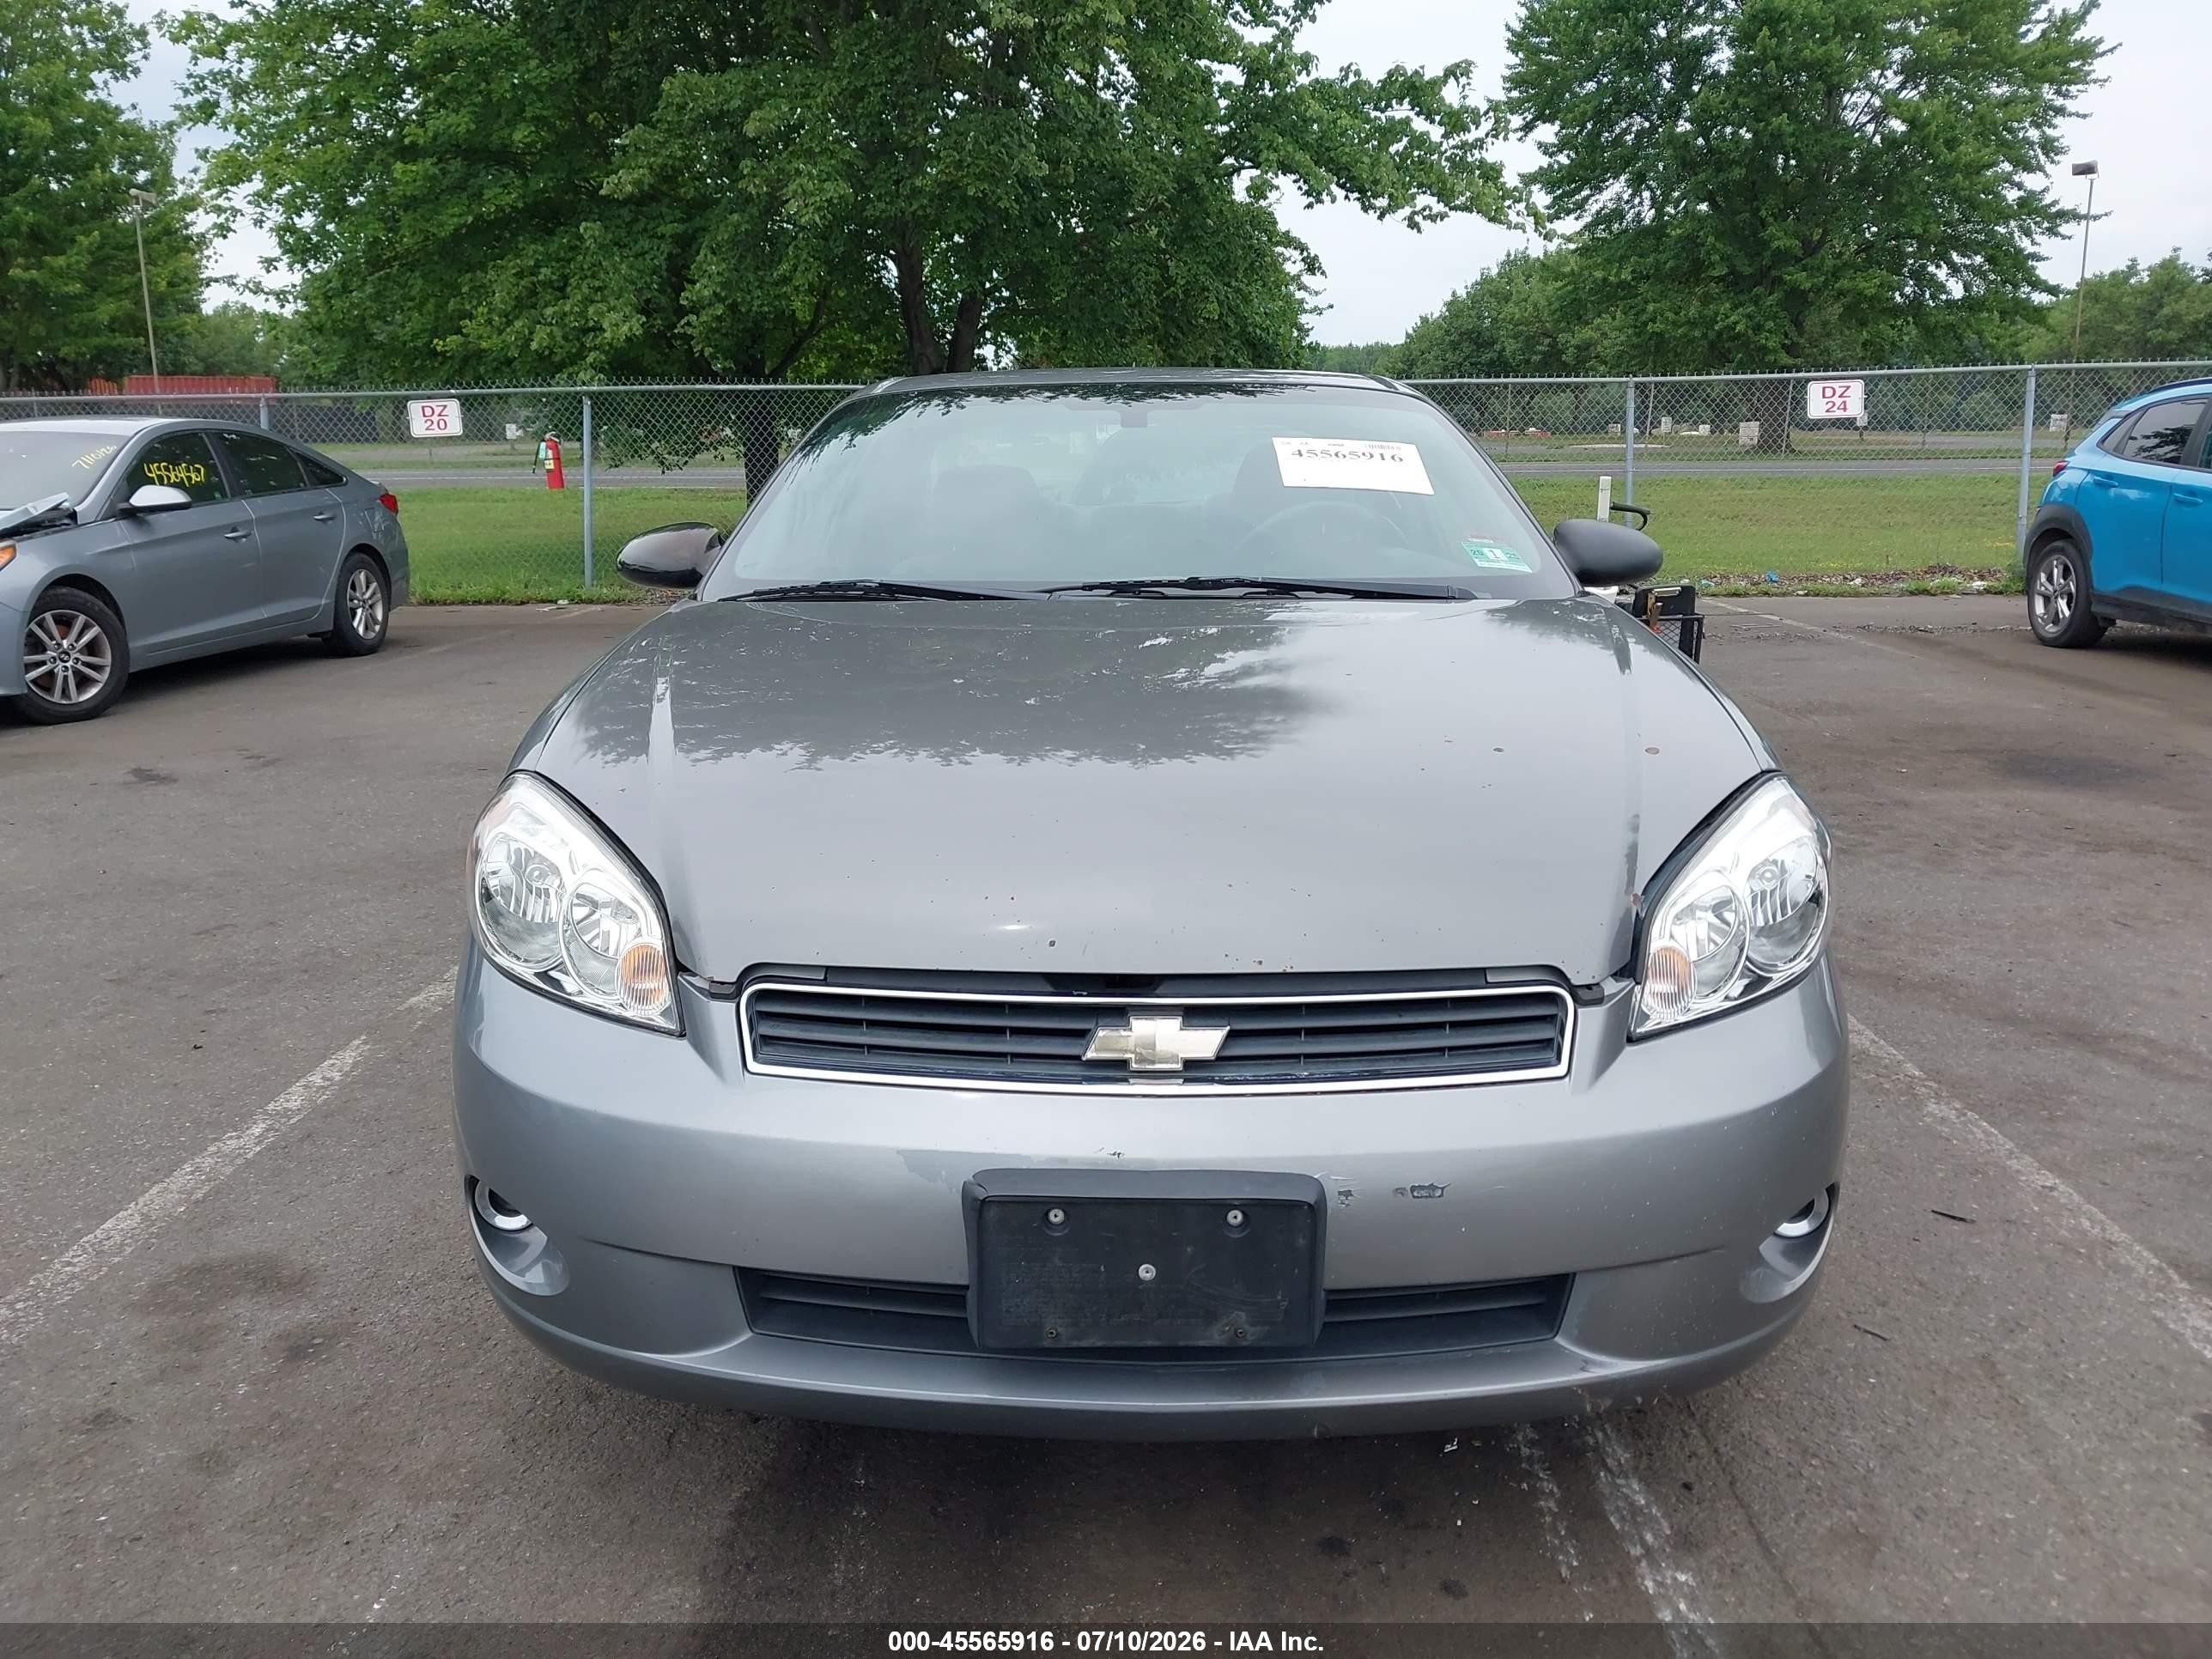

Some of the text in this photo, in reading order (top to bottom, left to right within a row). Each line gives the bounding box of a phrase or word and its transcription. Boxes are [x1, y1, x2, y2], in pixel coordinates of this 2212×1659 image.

[1821, 385, 1851, 399] DZ
[421, 404, 449, 418] DZ
[1825, 399, 1848, 413] 24
[424, 418, 448, 431] 20
[1291, 448, 1404, 463] 45565916
[143, 462, 205, 488] 45564567
